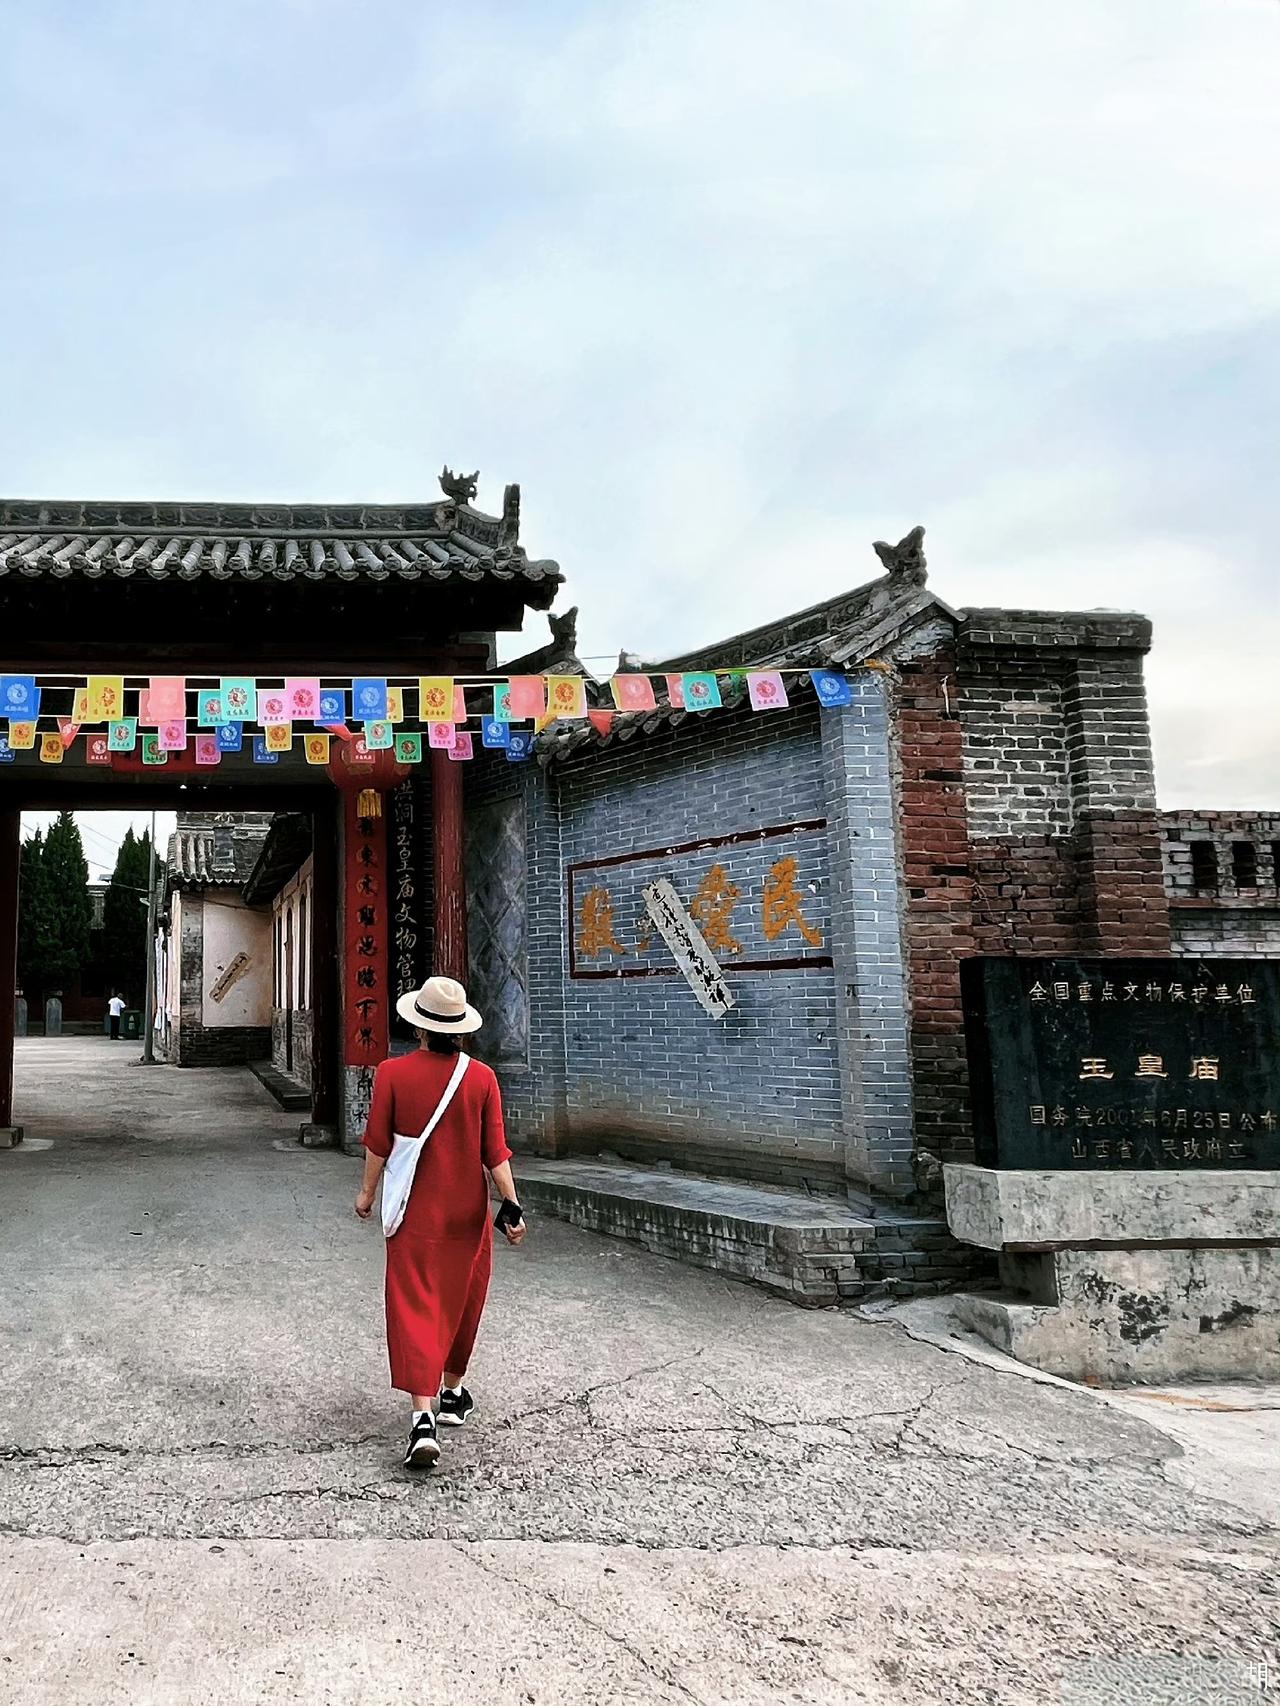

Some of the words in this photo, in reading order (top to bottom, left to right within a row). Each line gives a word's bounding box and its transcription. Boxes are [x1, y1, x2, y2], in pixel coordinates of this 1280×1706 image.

[393, 779, 418, 1023] 洪洞玉皇庙文物管理
[1029, 980, 1257, 1004] 全国重点文物保护单位
[1079, 1053, 1221, 1081] 玉皇庙
[1071, 1136, 1247, 1161] 山西省人民政府立
